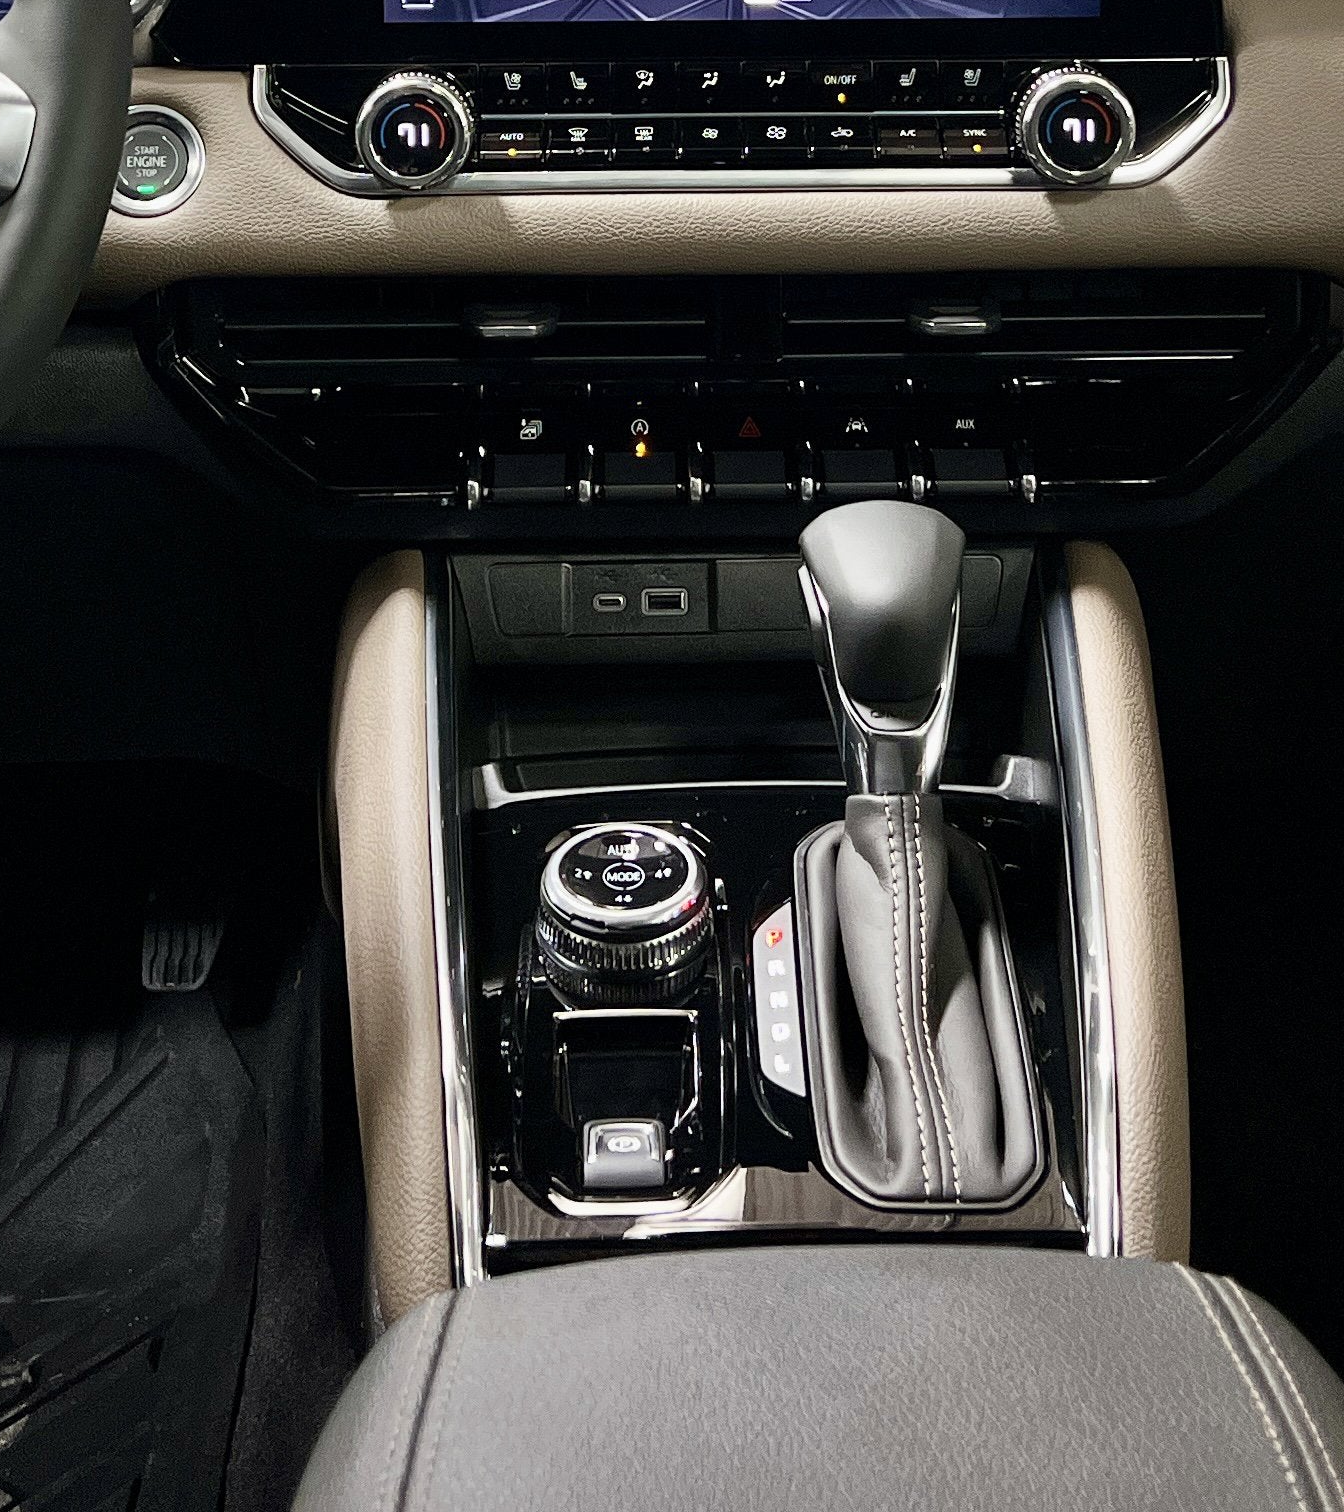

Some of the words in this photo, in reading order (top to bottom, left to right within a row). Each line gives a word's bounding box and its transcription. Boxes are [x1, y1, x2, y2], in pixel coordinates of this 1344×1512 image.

[824, 75, 857, 85] ON/OFF
[499, 132, 524, 141] AUTO
[899, 129, 916, 137] A/C
[963, 128, 988, 137] SYNC
[134, 145, 159, 155] START
[126, 155, 167, 168] ENGINE
[136, 169, 157, 178] STOP
[956, 419, 975, 430] AUX
[607, 844, 639, 858] AU
[606, 871, 641, 882] MODE
[765, 929, 783, 948] P
[767, 959, 786, 977] R
[774, 1053, 790, 1073] L
